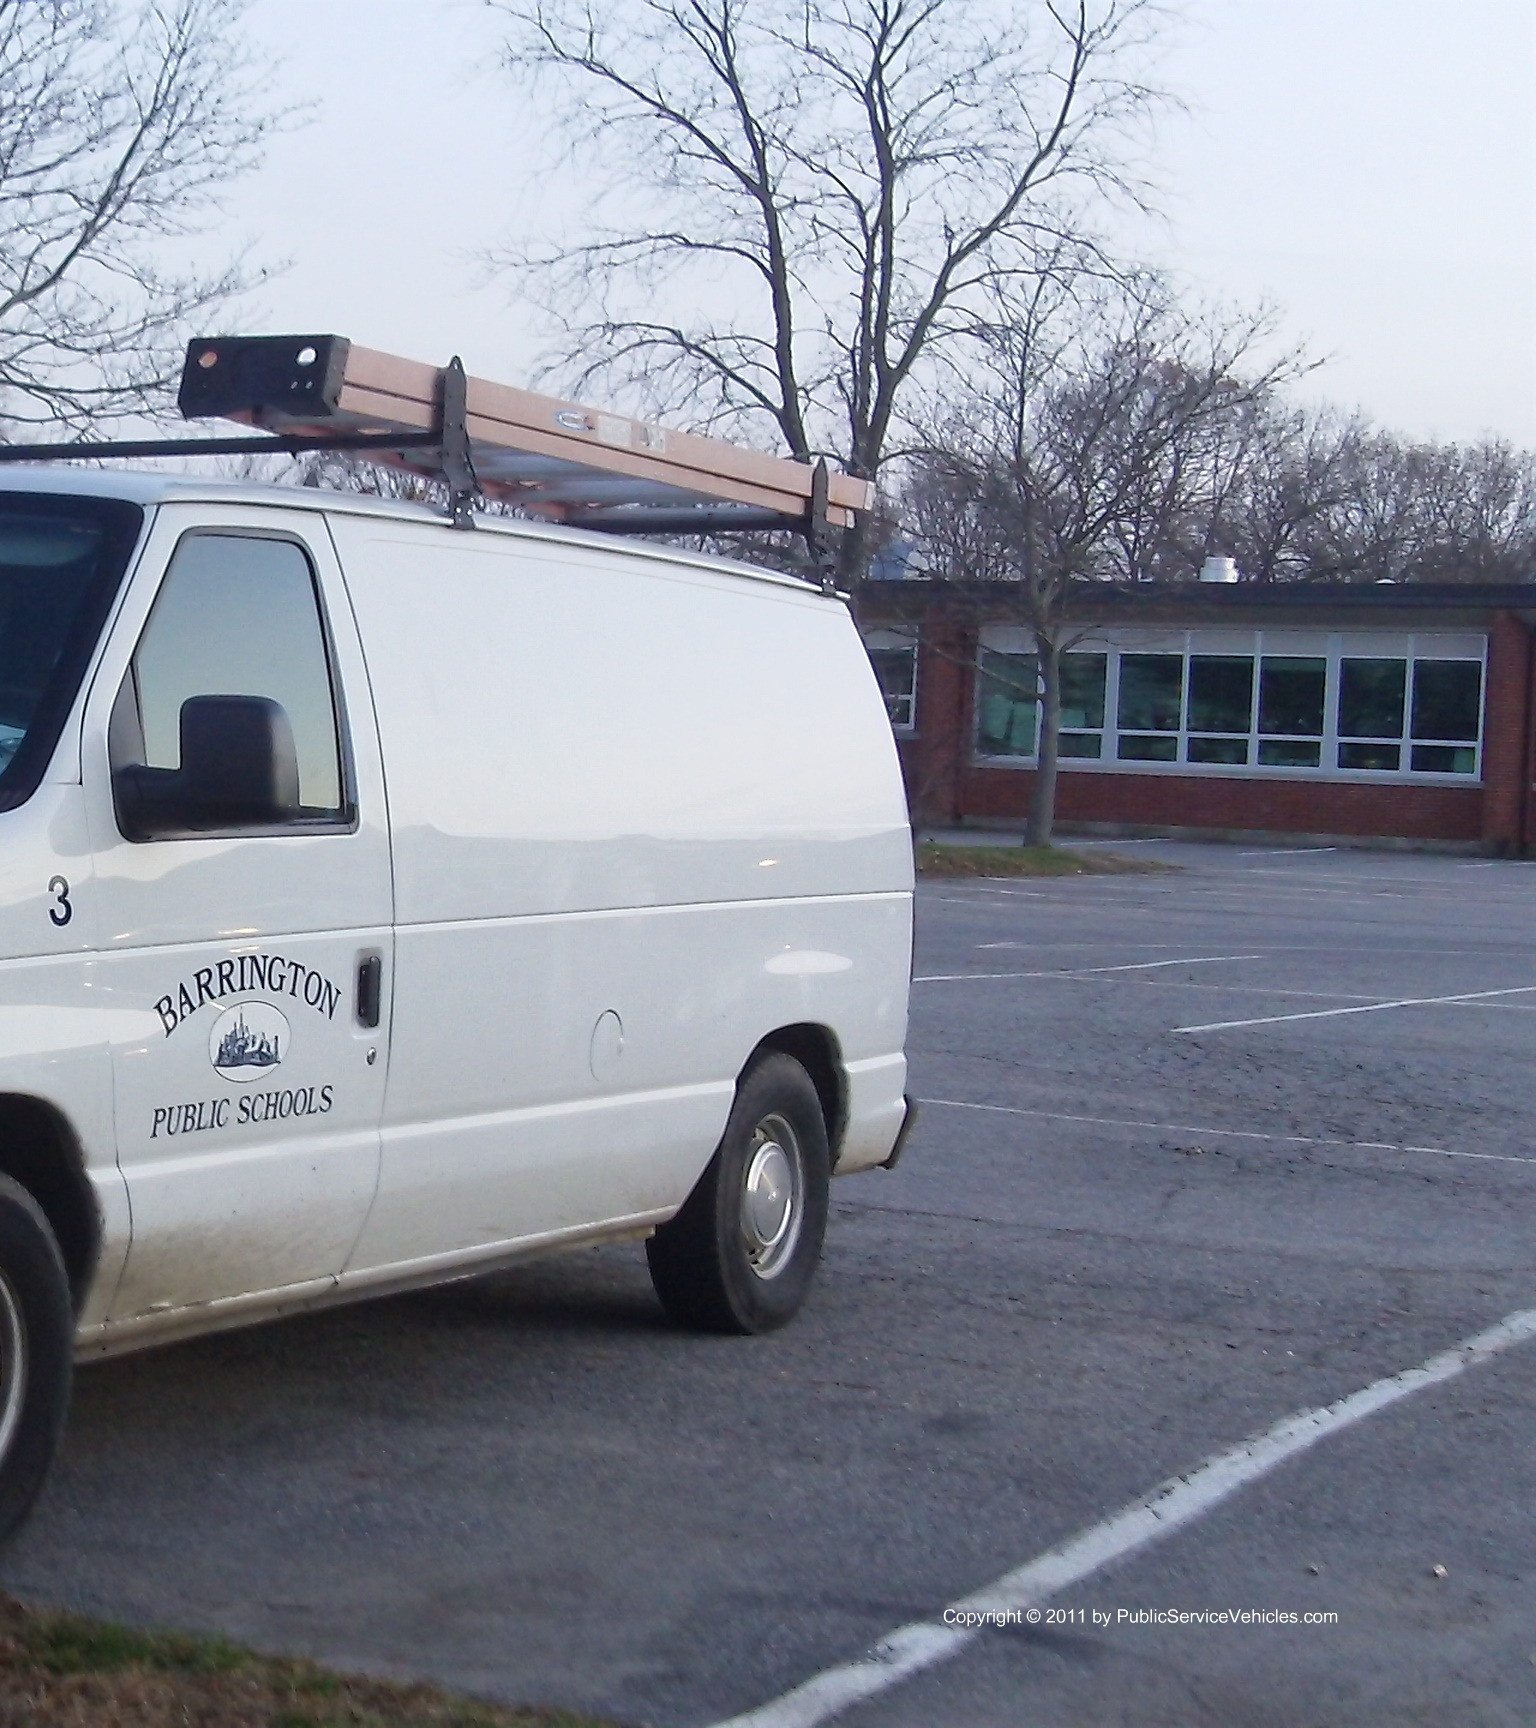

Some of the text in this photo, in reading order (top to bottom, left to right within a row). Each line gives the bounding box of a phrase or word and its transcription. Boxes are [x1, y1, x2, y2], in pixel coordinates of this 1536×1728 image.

[48, 875, 72, 926] 3
[153, 954, 342, 1038] BARRINGTON
[150, 1085, 334, 1139] PUBLIC SCHOOLS
